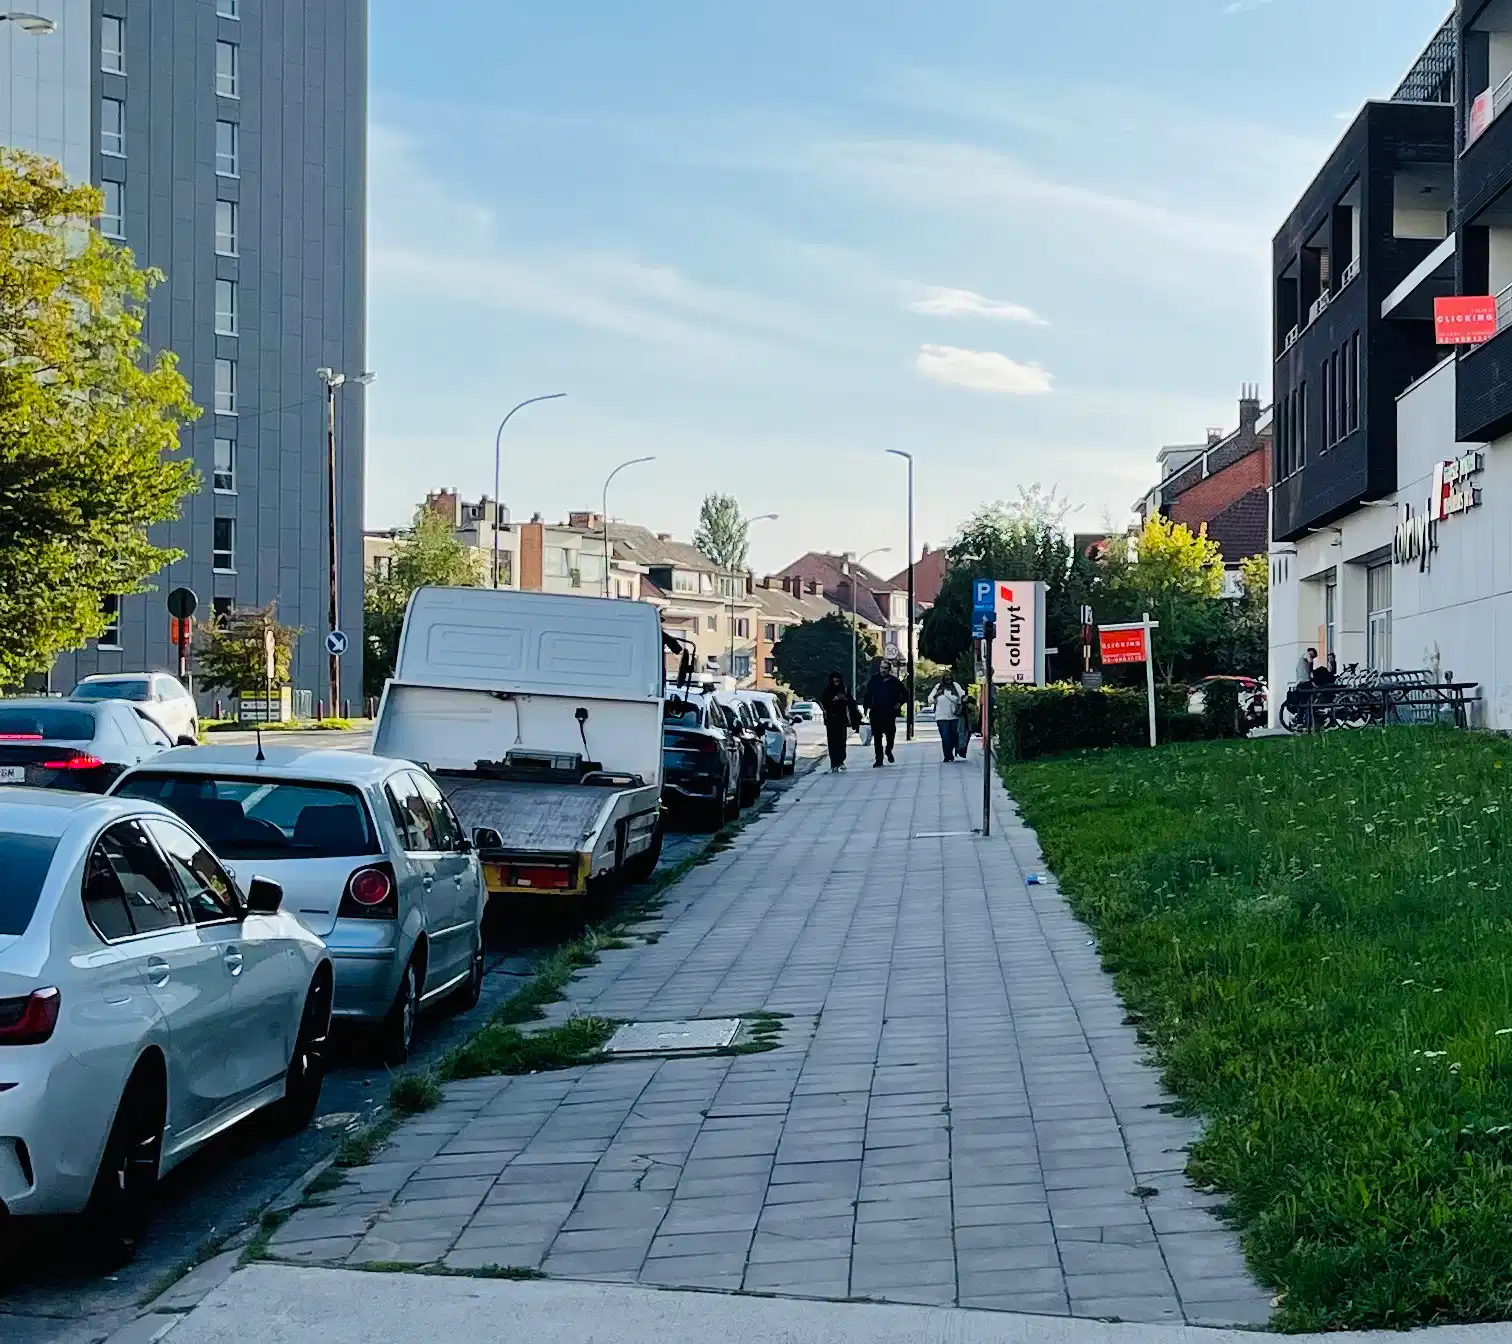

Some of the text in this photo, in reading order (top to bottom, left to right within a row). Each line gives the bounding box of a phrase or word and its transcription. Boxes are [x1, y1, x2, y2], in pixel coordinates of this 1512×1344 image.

[1436, 313, 1493, 324] CLICKING
[977, 582, 991, 602] P
[1005, 605, 1025, 667] colruyt
